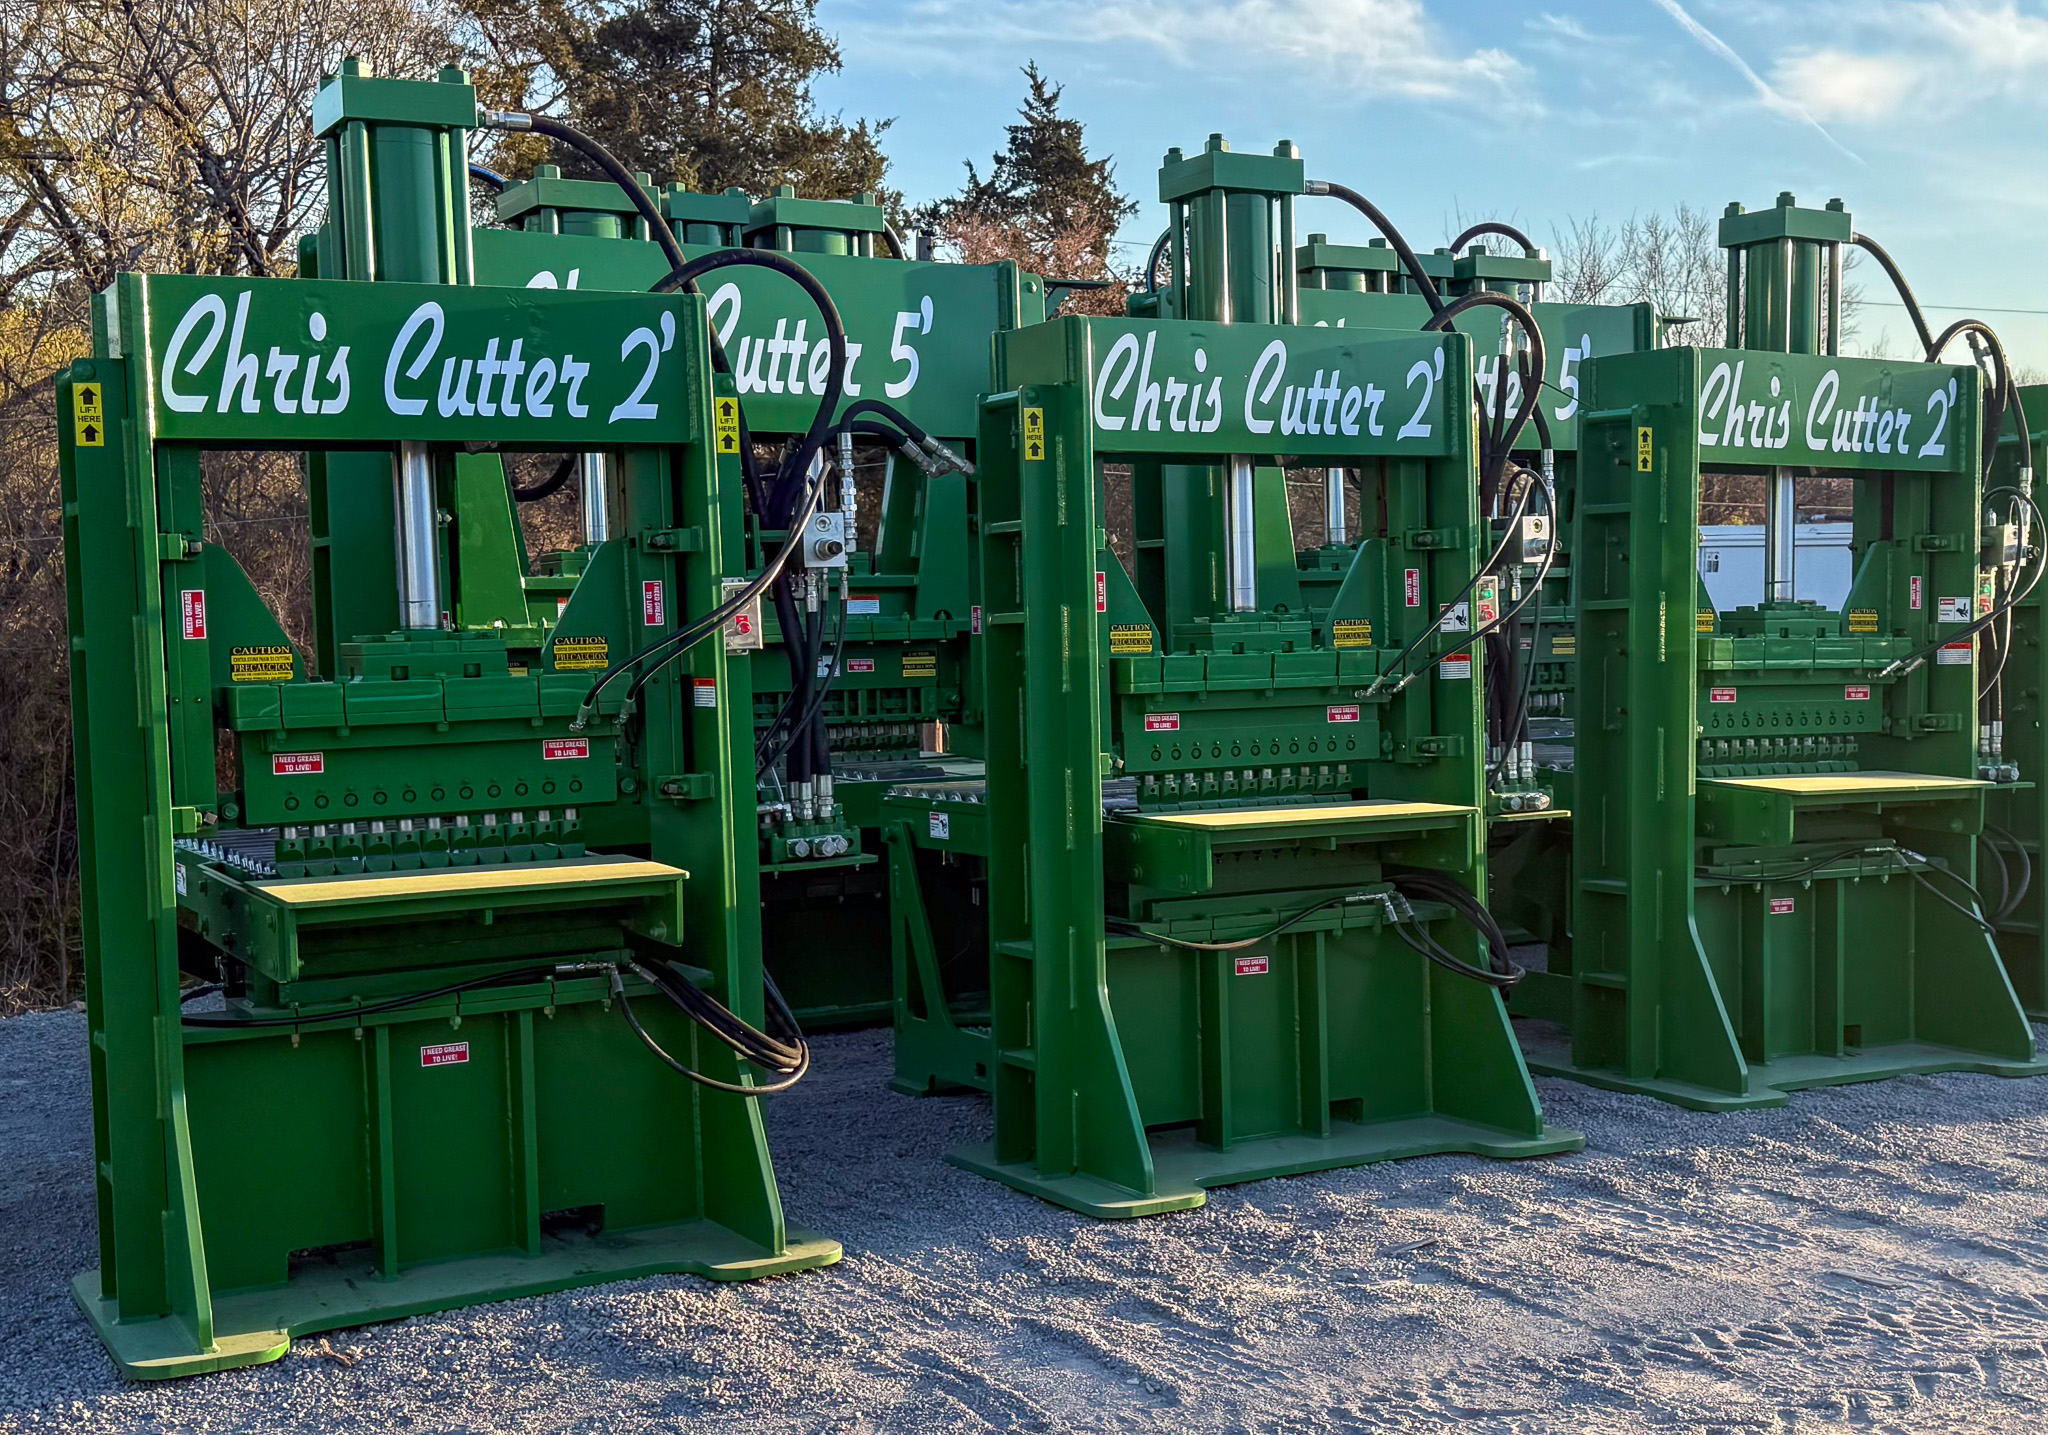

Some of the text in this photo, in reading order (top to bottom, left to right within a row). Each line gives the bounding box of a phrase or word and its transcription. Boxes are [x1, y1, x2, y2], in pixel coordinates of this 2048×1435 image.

[884, 295, 934, 398] 5'
[162, 290, 676, 424] Chris Cutter 2'
[1094, 330, 1445, 441] Chris Cutter 2'
[79, 406, 98, 414] LIFT
[1700, 360, 1957, 459] Chris Cutter 2'
[77, 415, 102, 423] HERE
[719, 417, 735, 425] LIFT
[718, 425, 737, 433] HERE
[184, 592, 193, 616] GREASE
[194, 601, 203, 628] TO LIVE!
[186, 616, 194, 634] NEED
[1111, 623, 1151, 631] CAUTION
[1334, 618, 1370, 626] CAUTION
[554, 636, 606, 645] CAUTION
[232, 645, 290, 655] CAUTION
[556, 652, 607, 661] PRECAUCION
[233, 662, 291, 672] PRECAUCION
[297, 755, 321, 763] GREASE
[426, 1047, 443, 1055] NEED
[443, 1044, 466, 1053] GREASE
[432, 1053, 458, 1063] TO LIVE!
